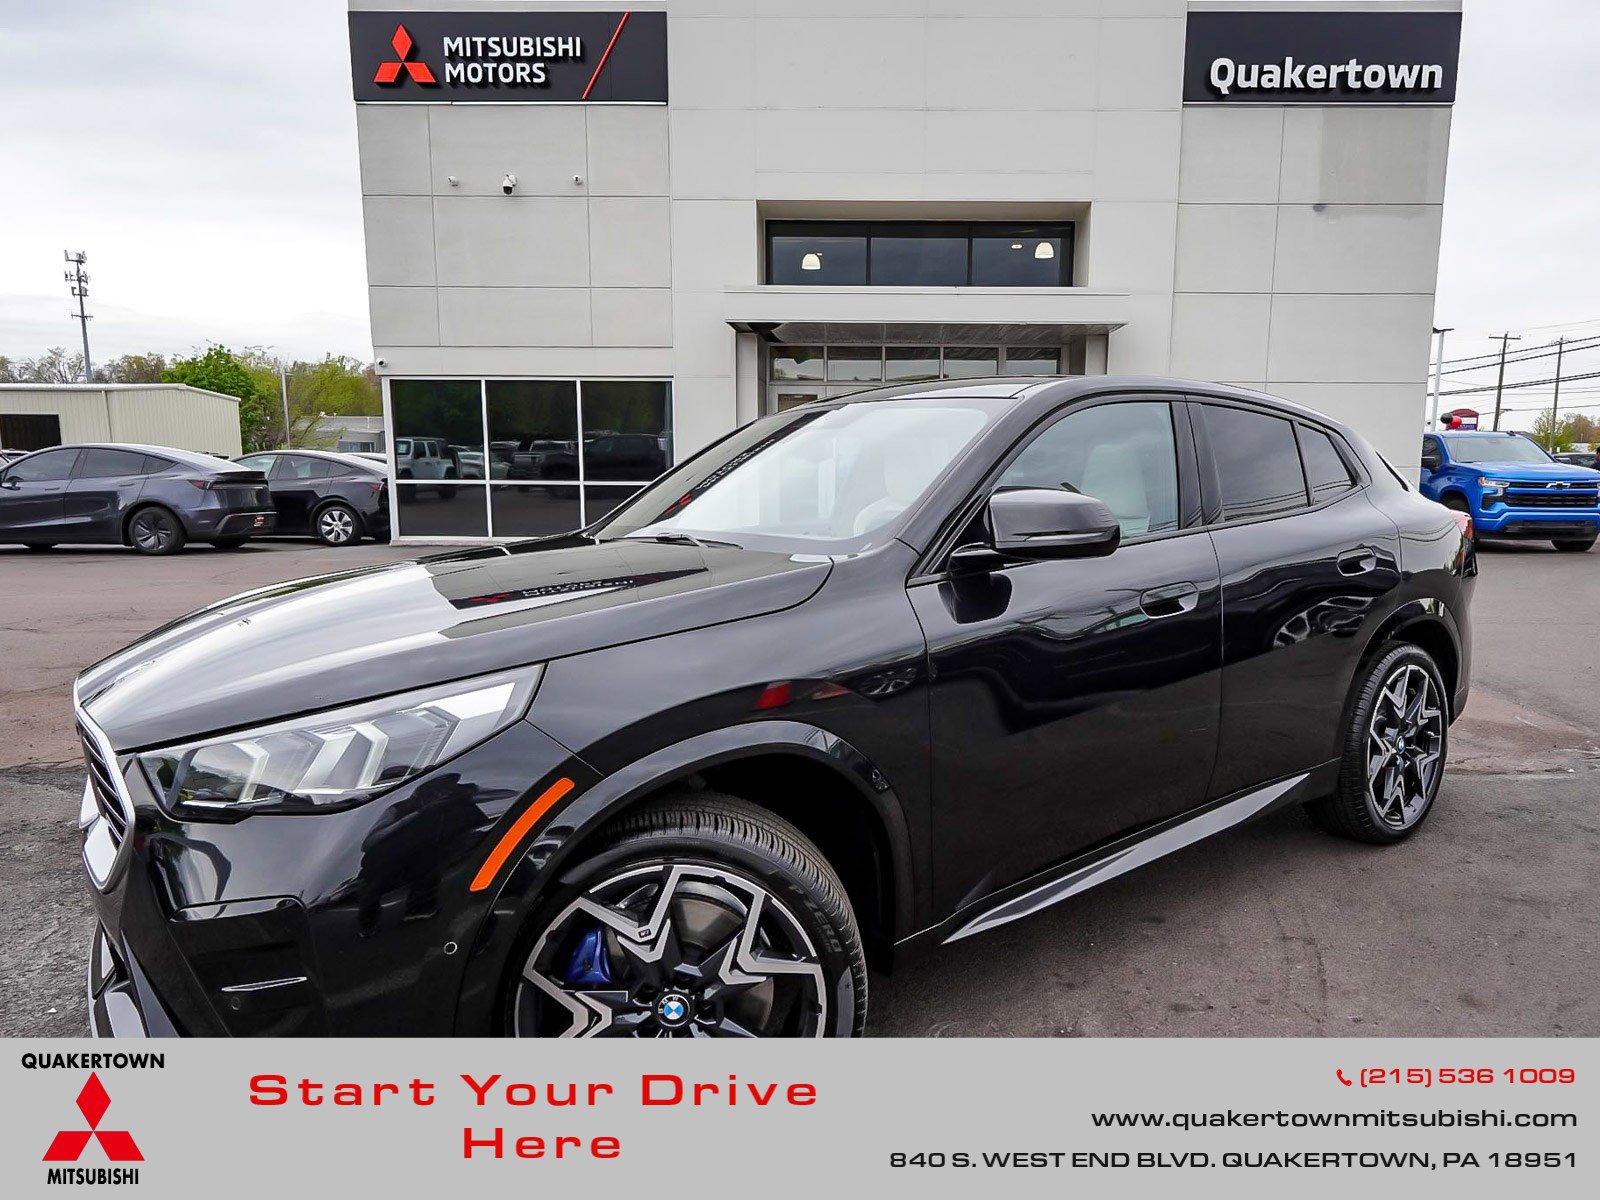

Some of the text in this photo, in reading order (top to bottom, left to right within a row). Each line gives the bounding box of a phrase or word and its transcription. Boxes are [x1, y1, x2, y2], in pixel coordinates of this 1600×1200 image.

[443, 36, 581, 57] MITSUBISHI
[444, 62, 546, 83] MOTORS
[1210, 56, 1443, 95] Quakertown
